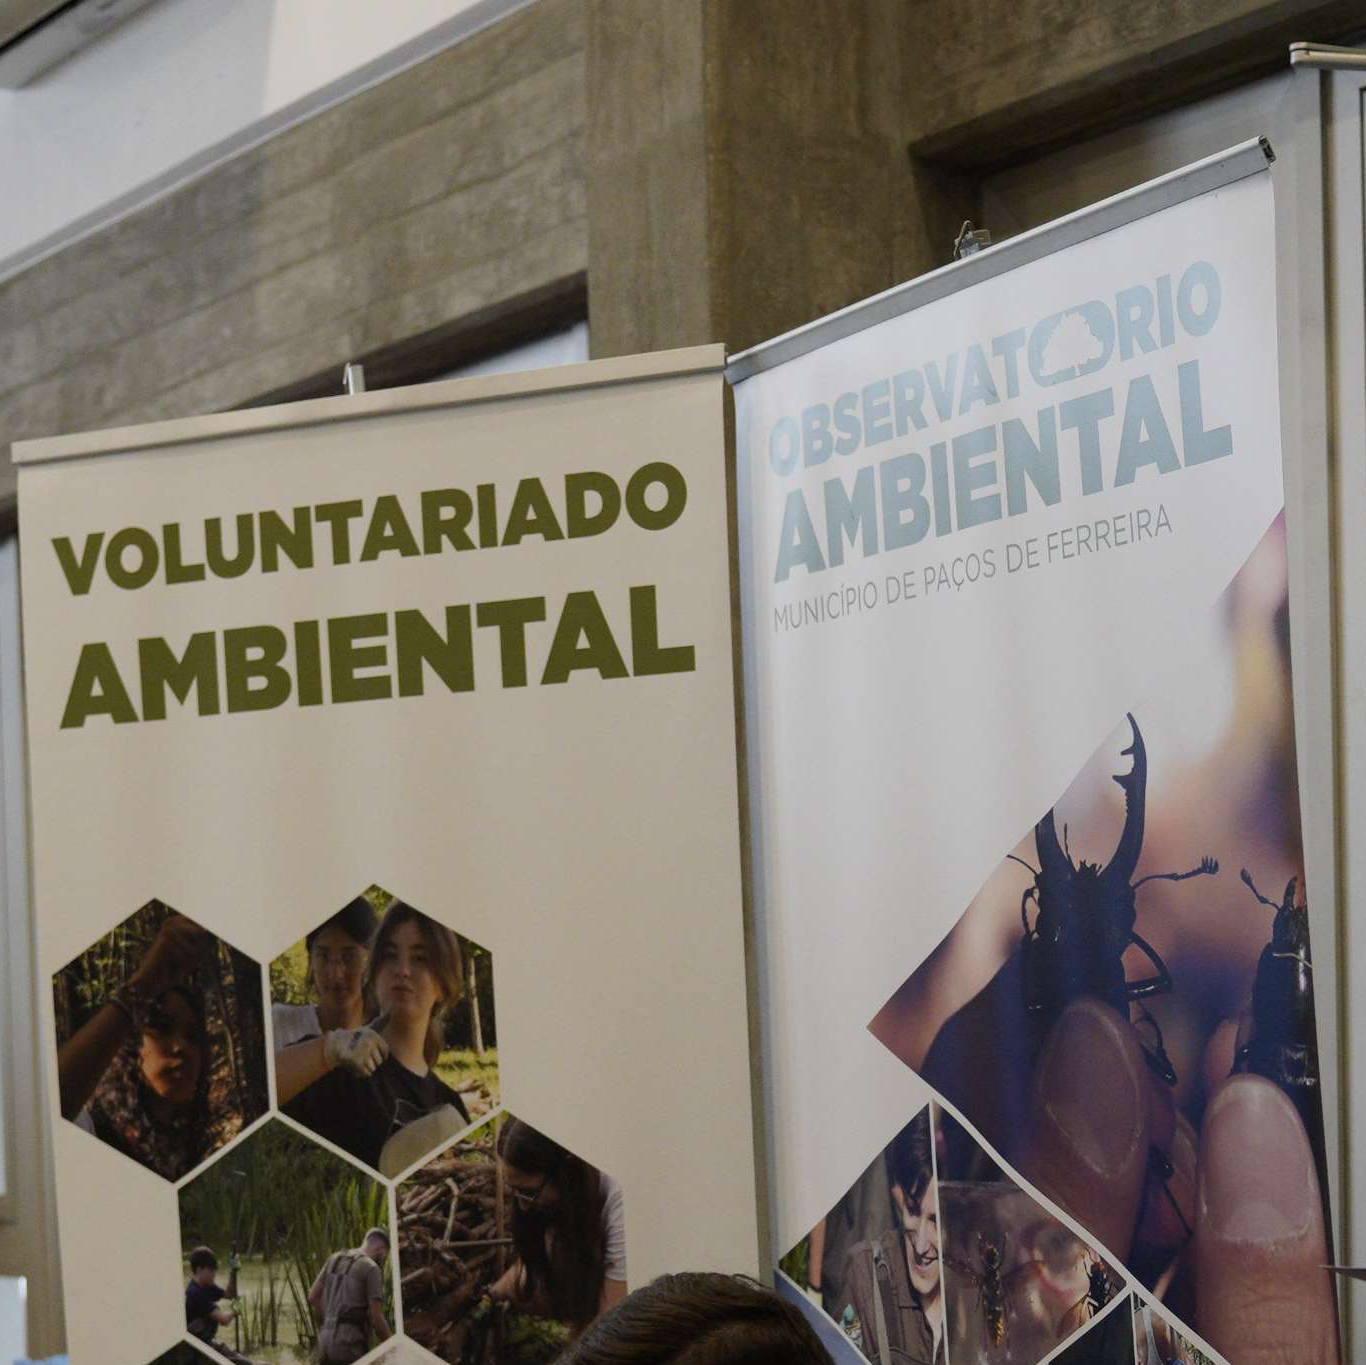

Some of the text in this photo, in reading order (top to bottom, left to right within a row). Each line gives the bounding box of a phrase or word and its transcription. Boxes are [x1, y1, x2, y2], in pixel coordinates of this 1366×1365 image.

[768, 261, 1222, 479] OBSERVATORIO
[52, 461, 688, 596] VOLUNTARIADO
[774, 359, 1233, 583] AMBIENTAL
[773, 503, 1173, 632] MUNICÍPIO DE PAÇOS DE FERREIRA
[60, 585, 696, 729] AMBIENTAL
